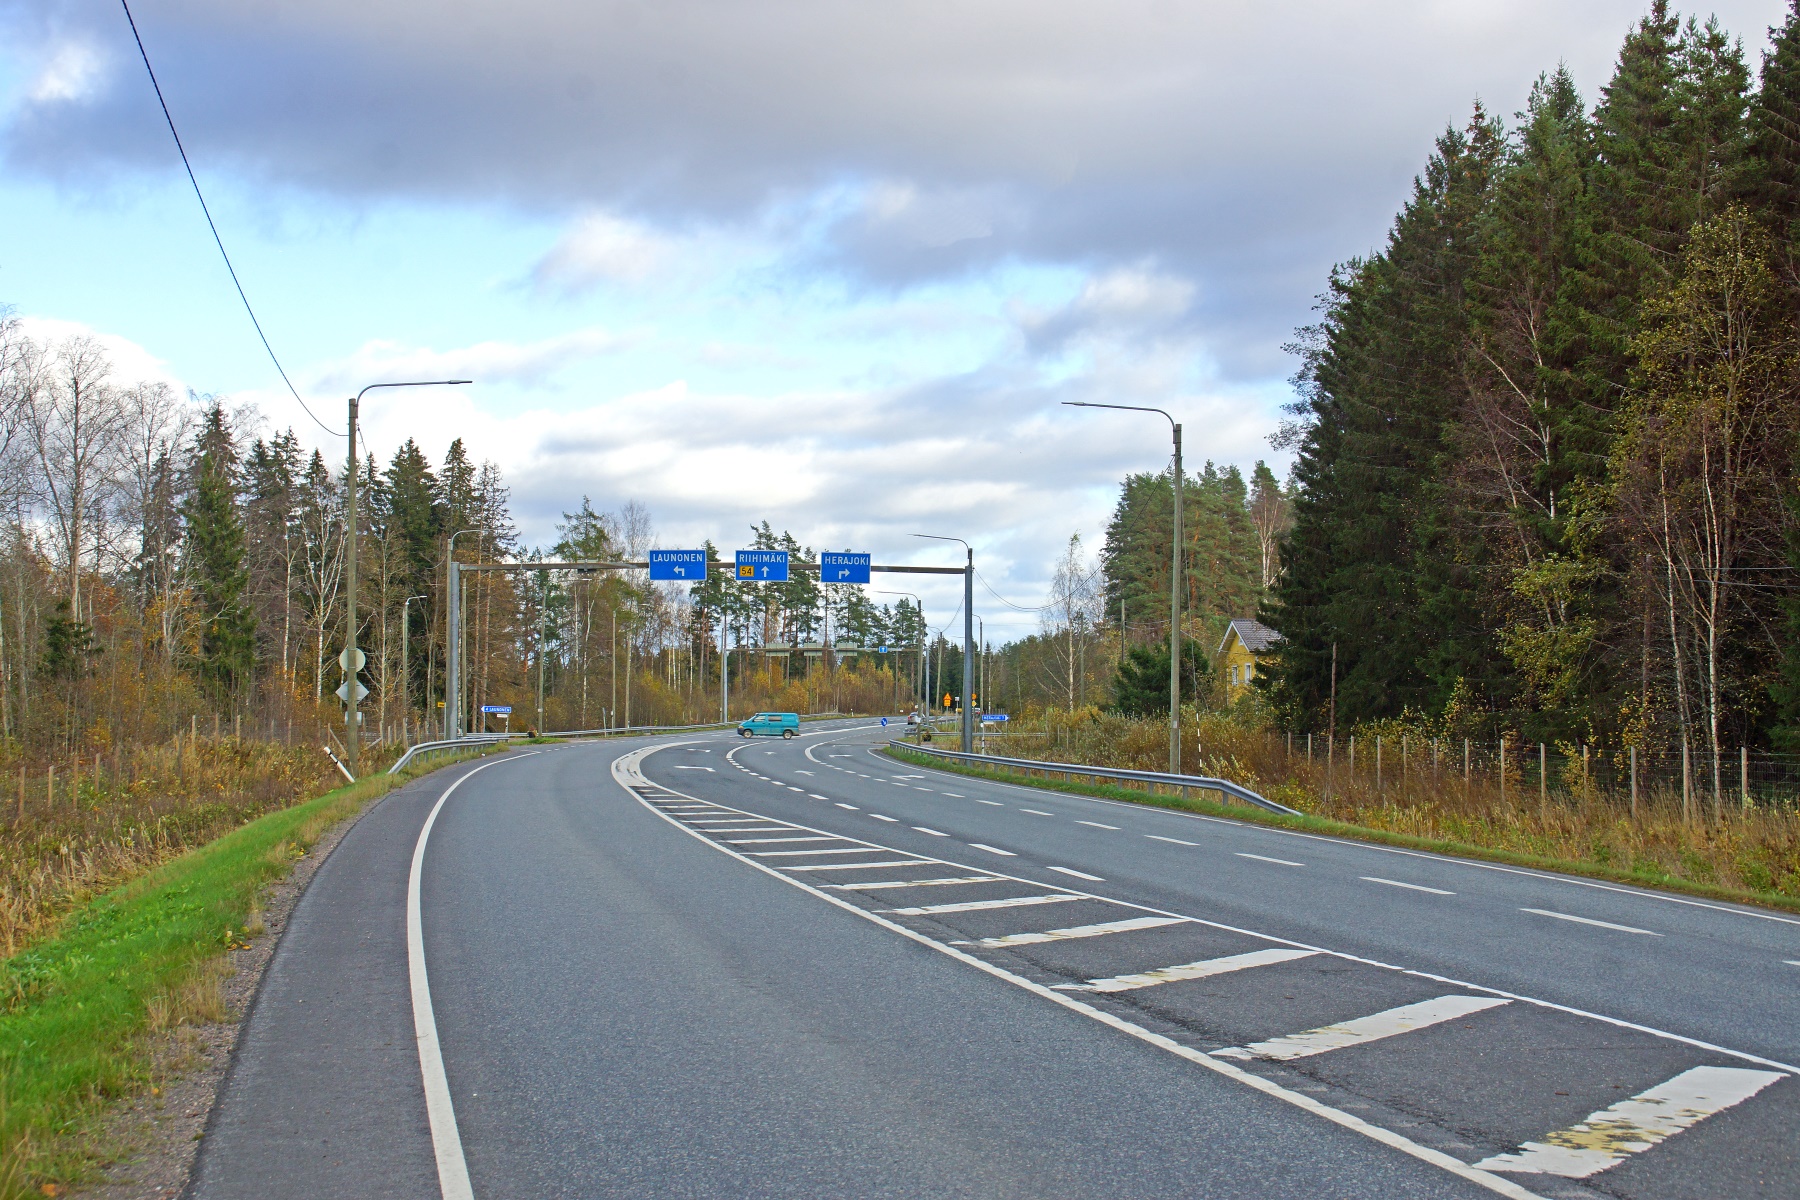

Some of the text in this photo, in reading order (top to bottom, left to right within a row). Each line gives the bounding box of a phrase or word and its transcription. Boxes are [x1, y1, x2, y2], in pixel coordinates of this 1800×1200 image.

[652, 553, 703, 562] LAUNONEN
[739, 552, 785, 563] RIIHIMÄKI
[824, 556, 869, 566] HERAJOKI
[741, 567, 752, 576] 54
